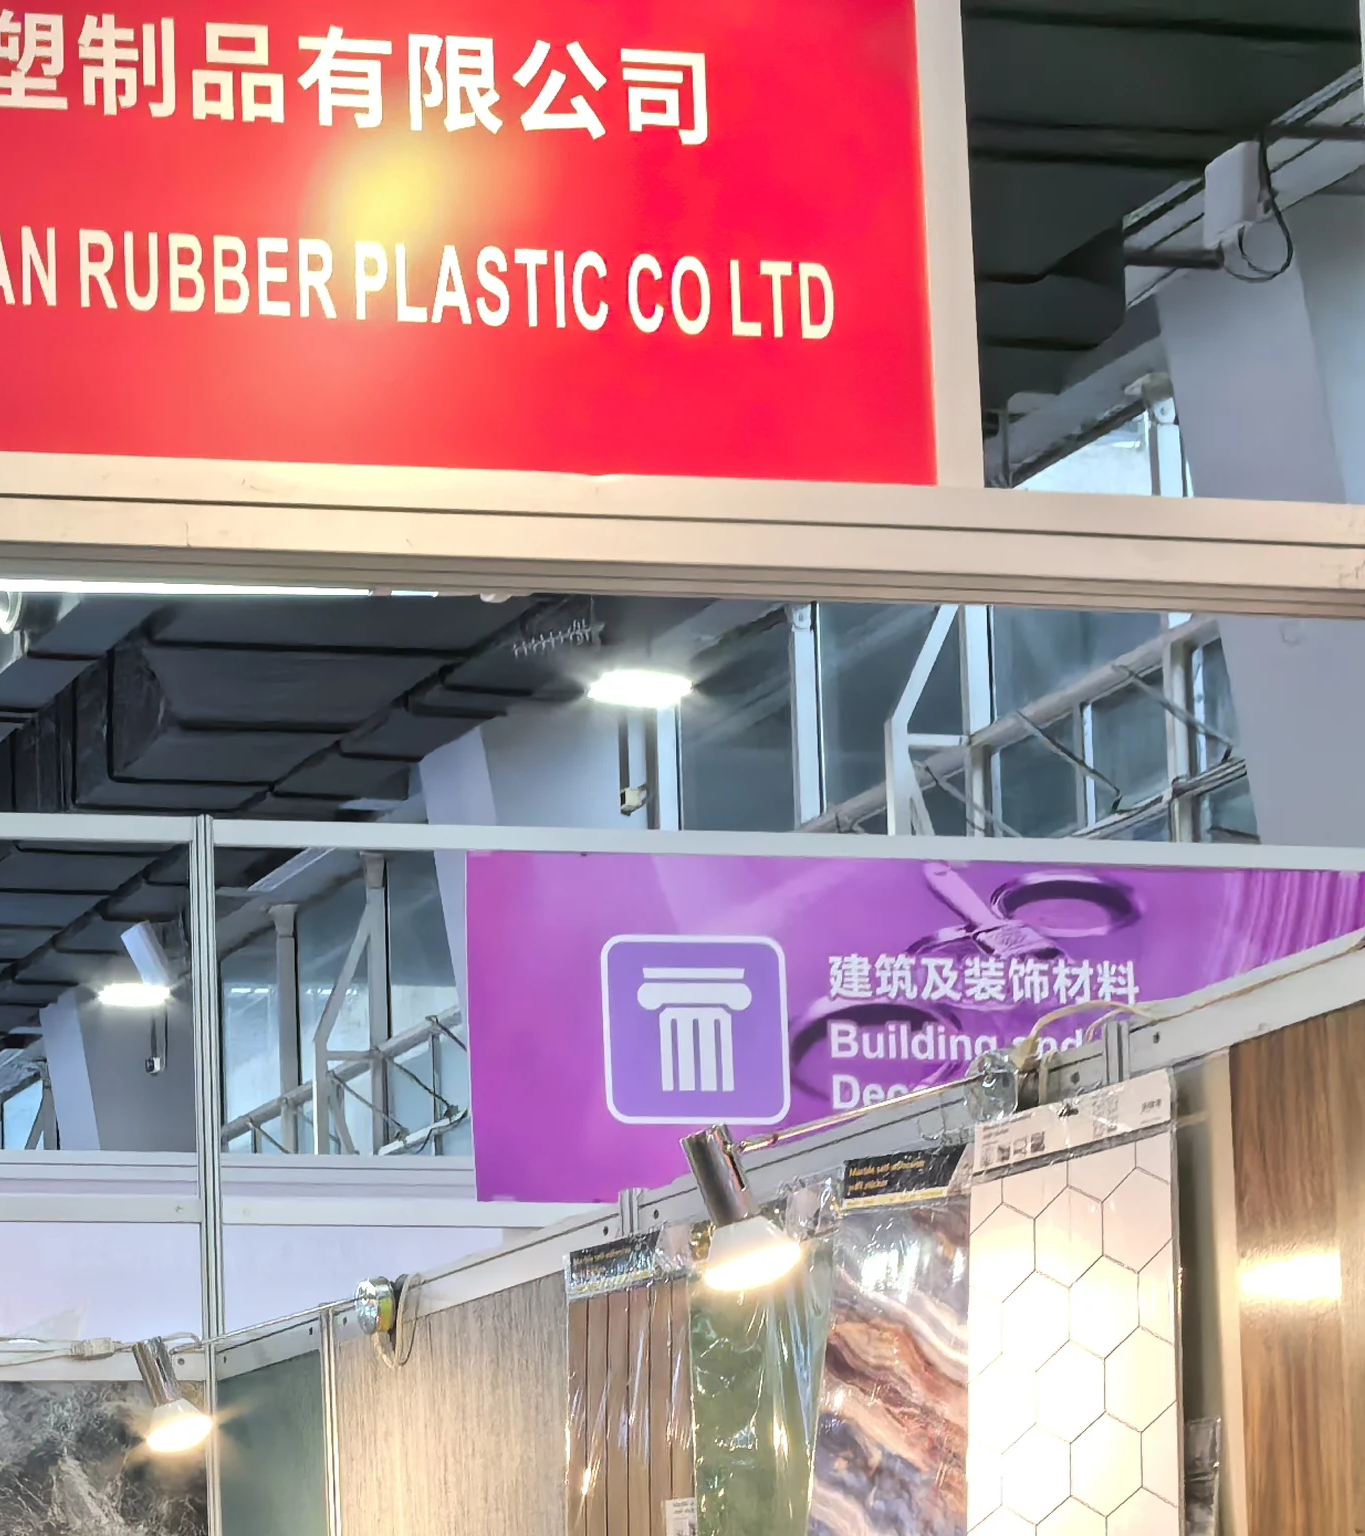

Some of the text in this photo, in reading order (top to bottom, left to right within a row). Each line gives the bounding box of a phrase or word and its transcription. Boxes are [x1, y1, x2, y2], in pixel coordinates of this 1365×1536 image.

[79, 229, 334, 319] RUBBER
[355, 241, 609, 330] PLASTIC
[629, 254, 711, 335] CO
[730, 260, 835, 339] LTD
[829, 953, 1139, 1004] 建筑及装饰材料
